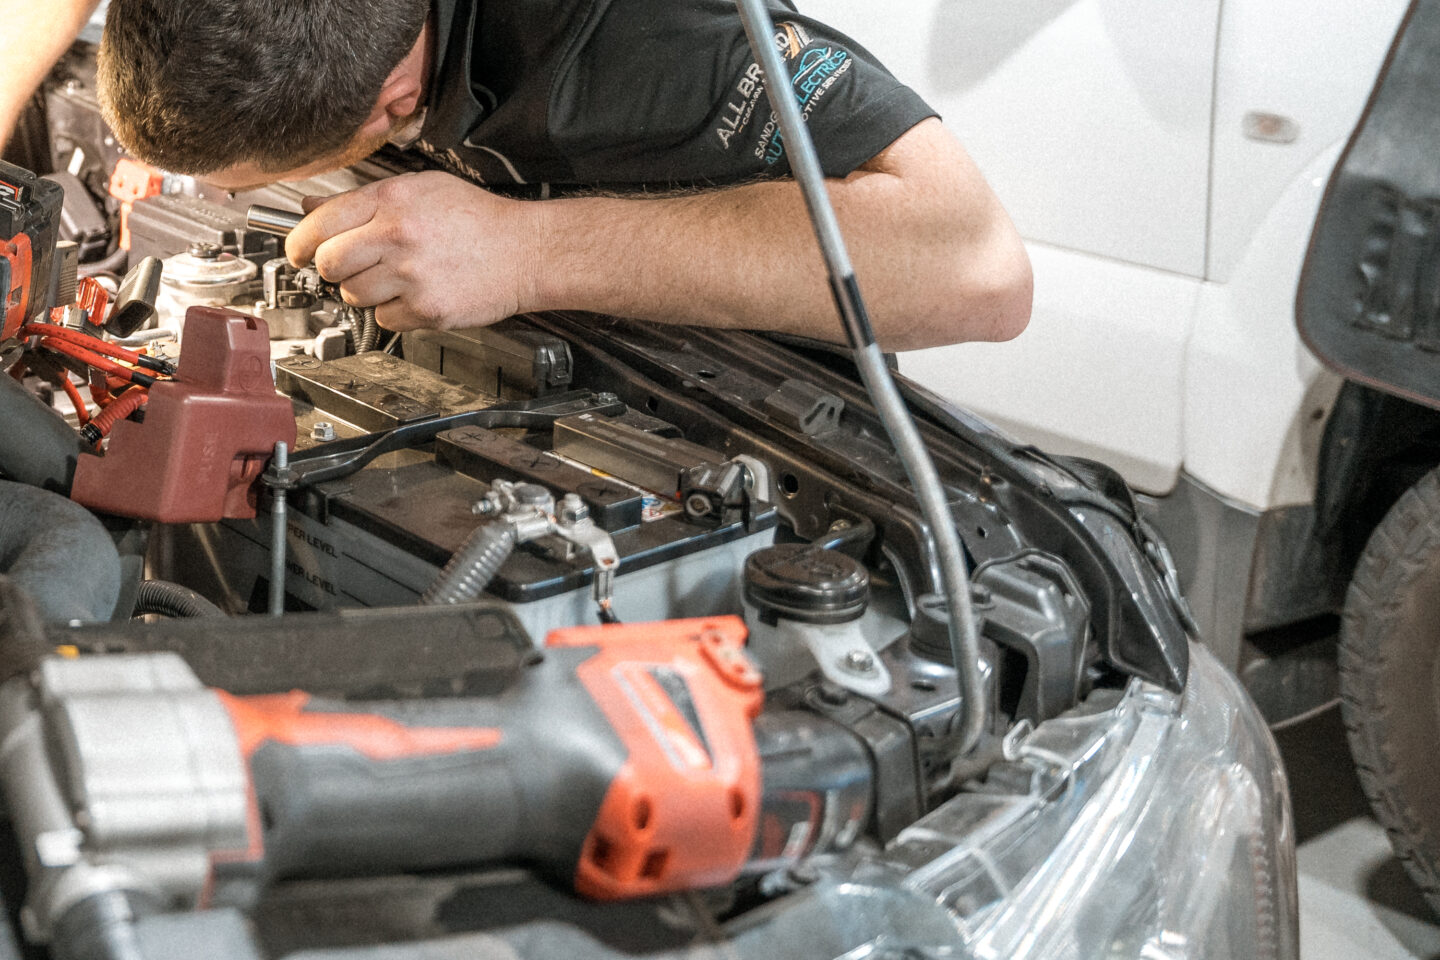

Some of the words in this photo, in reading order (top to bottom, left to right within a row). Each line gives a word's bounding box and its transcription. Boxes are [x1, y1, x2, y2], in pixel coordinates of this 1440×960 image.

[716, 101, 747, 150] ALL
[736, 32, 789, 99] BRD
[795, 50, 847, 107] LECTRICS
[754, 110, 779, 159] SANDG
[288, 523, 306, 541] PER
[306, 534, 338, 558] LEVEL
[306, 571, 337, 596] LEVEL
